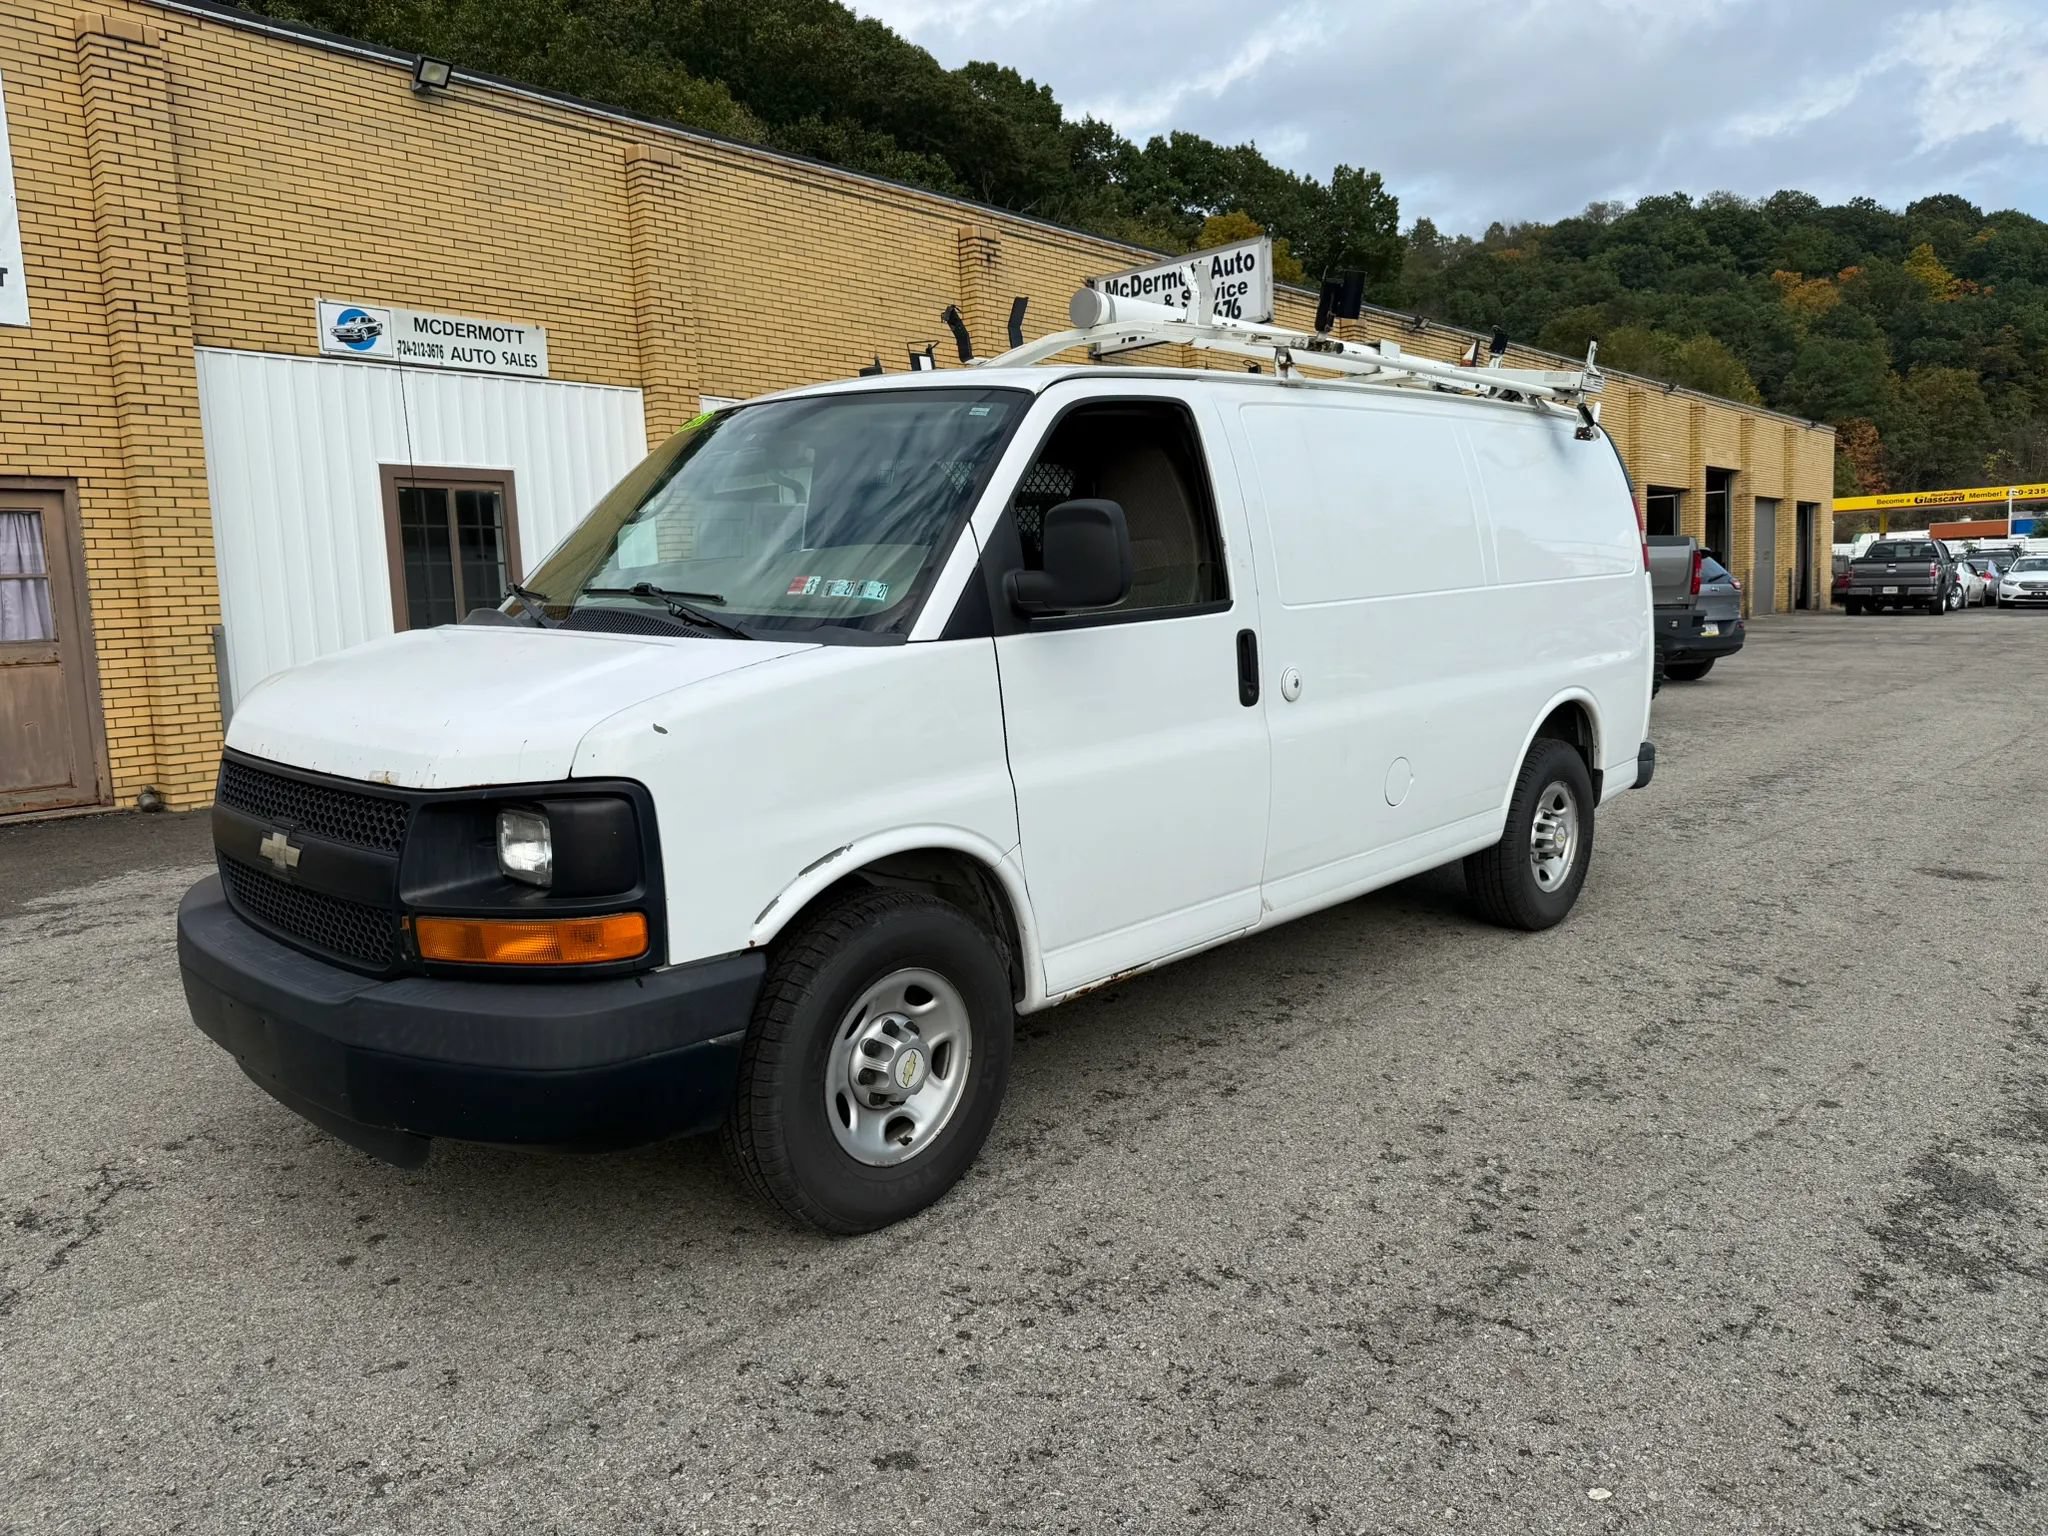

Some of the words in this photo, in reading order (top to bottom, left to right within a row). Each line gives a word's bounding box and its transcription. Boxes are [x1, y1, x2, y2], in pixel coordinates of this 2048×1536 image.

[1105, 260, 1202, 297] McDermo
[1211, 250, 1255, 279] Auto
[413, 317, 525, 345] MCDERMOTT
[397, 339, 444, 359] 724-212-3676
[451, 346, 496, 365] AUTO
[502, 351, 538, 368] SALES
[1914, 494, 1965, 504] Glasscard
[1969, 491, 2002, 499] Member!
